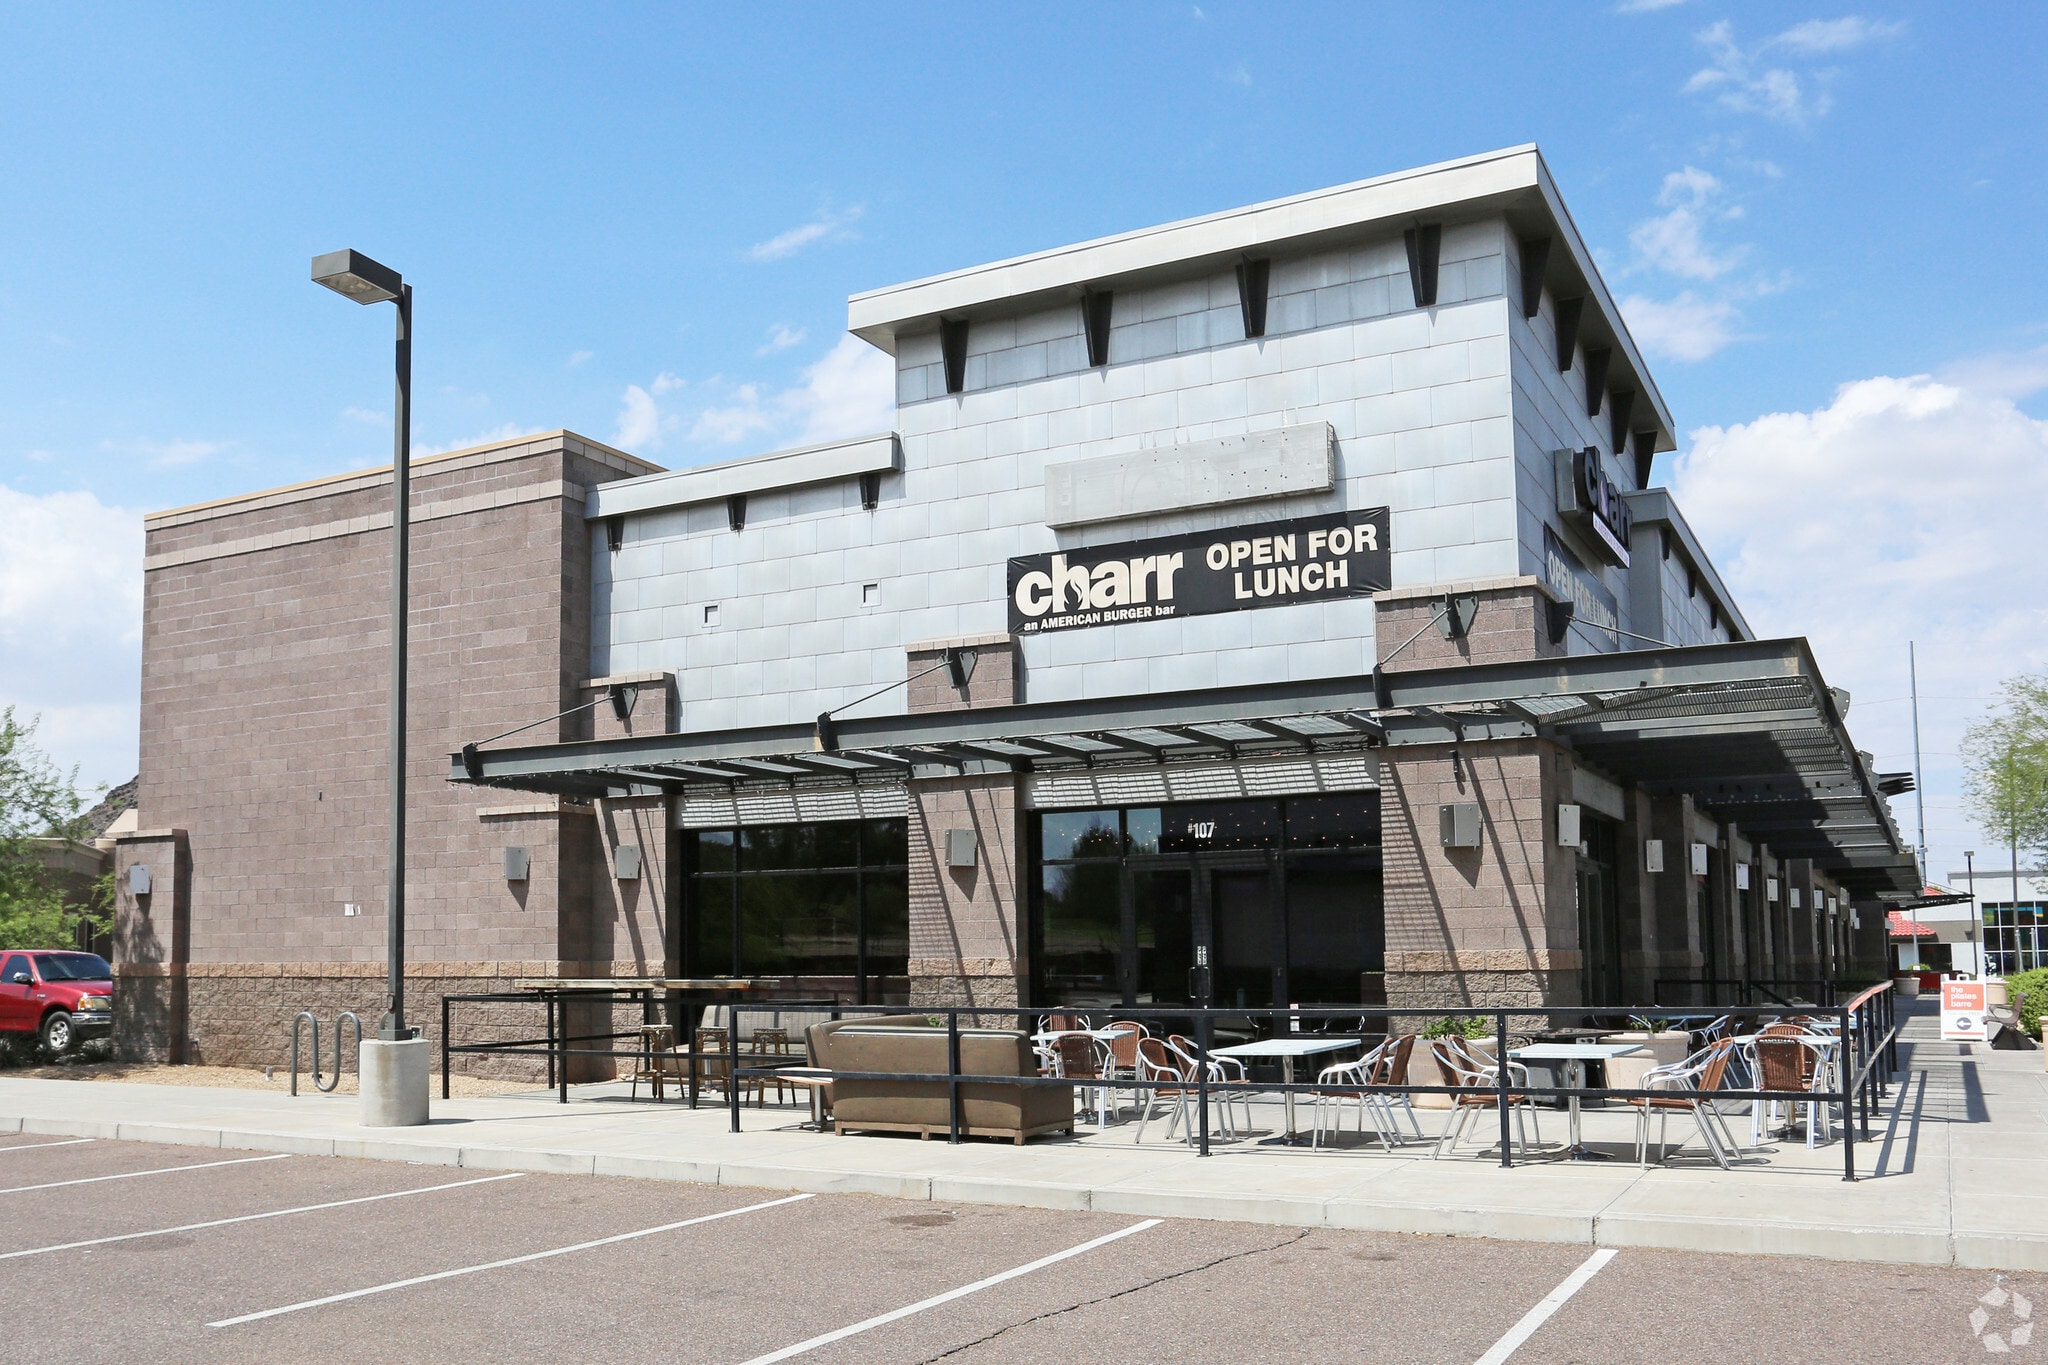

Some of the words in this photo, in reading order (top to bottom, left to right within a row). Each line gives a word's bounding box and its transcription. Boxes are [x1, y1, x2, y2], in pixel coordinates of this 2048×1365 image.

[1582, 446, 1632, 551] charr
[1206, 533, 1297, 571] OPEN
[1308, 523, 1378, 559] FOR
[1015, 551, 1184, 617] charr
[1234, 559, 1349, 600] LUNCH
[1548, 550, 1573, 600] OPEN
[1574, 576, 1591, 617] FOR
[1592, 595, 1618, 645] LUNCH
[1024, 622, 1038, 631] an
[1040, 612, 1101, 630] AMERICAN
[1103, 606, 1152, 621] BURGER
[1155, 605, 1176, 616] bar
[1187, 822, 1215, 839] #107
[1950, 993, 1977, 1001] pilates
